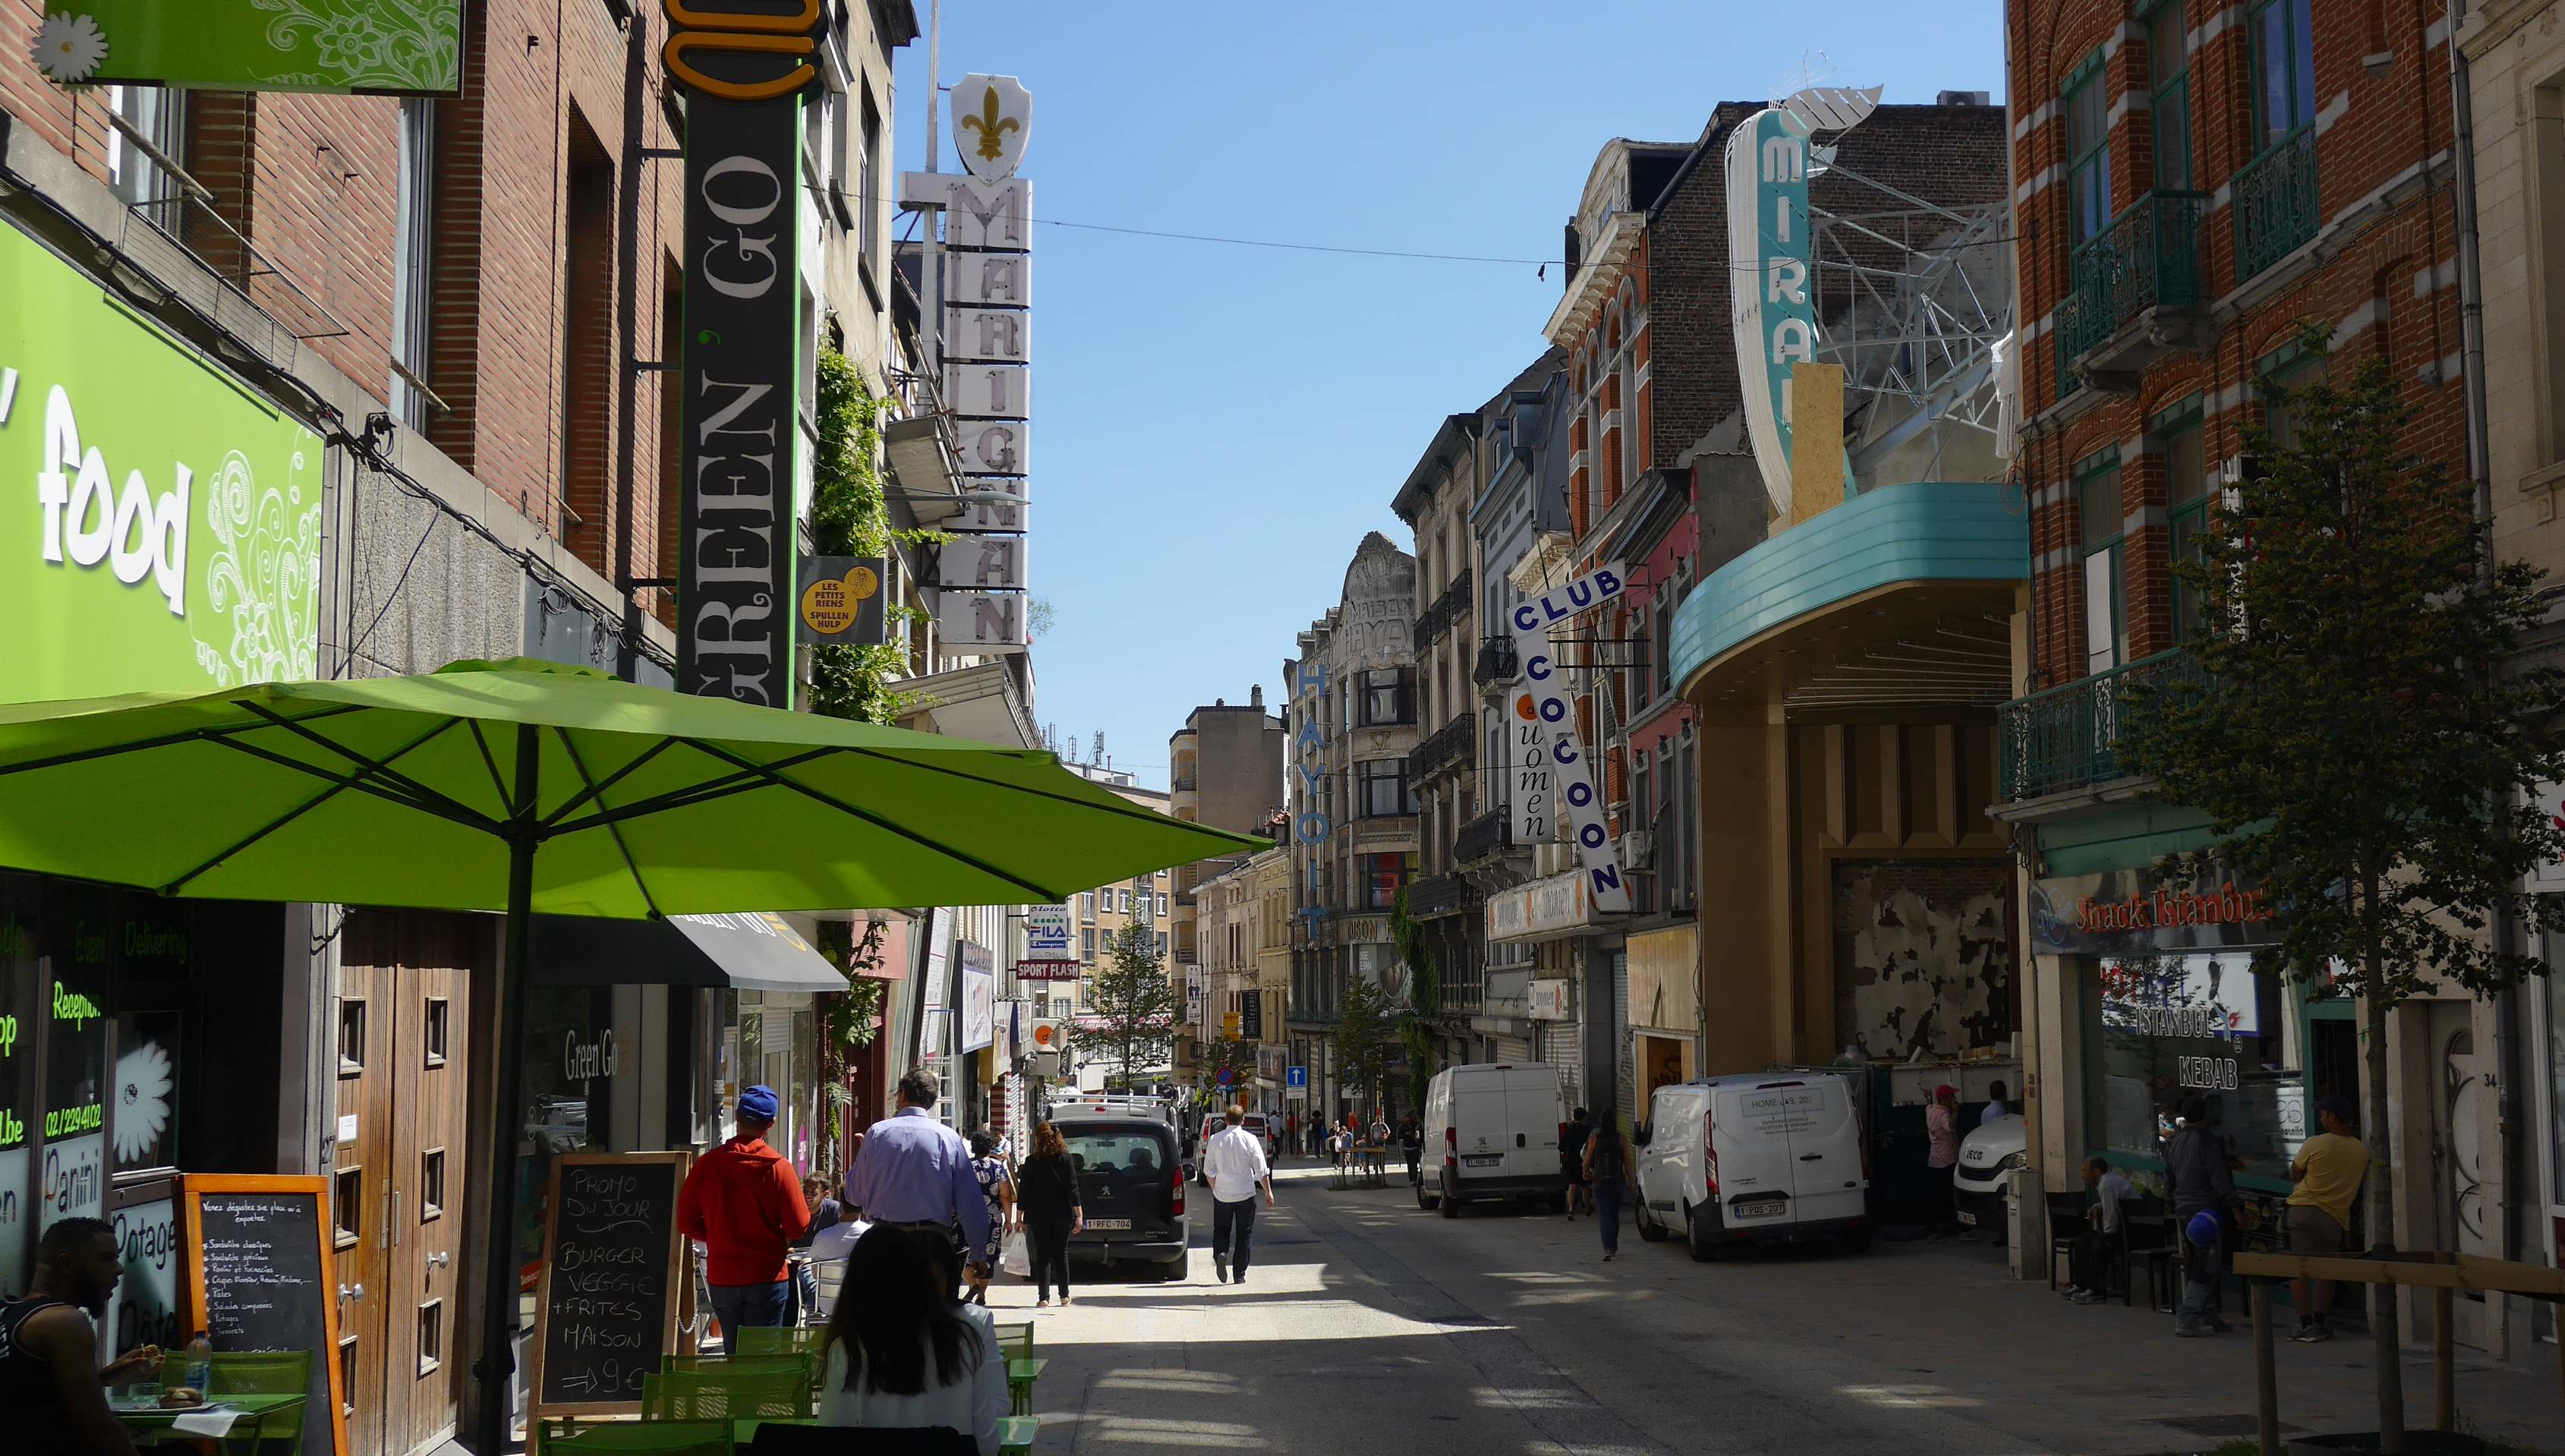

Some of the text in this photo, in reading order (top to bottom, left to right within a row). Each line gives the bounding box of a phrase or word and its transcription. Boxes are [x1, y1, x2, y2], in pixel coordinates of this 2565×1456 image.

[1763, 136, 1810, 424] MIRA
[950, 184, 1019, 643] MARIGNAN
[38, 383, 193, 616] food
[810, 611, 849, 619] SPULLEN
[1353, 598, 1414, 622] MAISON
[1514, 570, 1621, 631] CLUB
[1345, 619, 1409, 655] HAYO
[1527, 654, 1620, 893] COCOON
[1297, 664, 1328, 941] HAYOIT
[2076, 890, 2152, 933] Snack
[124, 920, 187, 965] Delivering
[1030, 926, 1066, 938] FILA
[1018, 963, 1078, 977] SPORT FLASH
[52, 980, 101, 1032] Reception
[2135, 1007, 2214, 1038] ISTANBUL
[2179, 1056, 2239, 1090] KEBAB
[2485, 1073, 2497, 1087] 34
[1752, 1099, 1777, 1108] HOME
[2029, 1087, 2035, 1098] 40
[1964, 1149, 1984, 1161] IVECO
[44, 1148, 99, 1217] Panini
[571, 1169, 636, 1201] PROMO
[603, 1199, 650, 1218] JOUR
[559, 1241, 645, 1271] BURGER
[215, 1313, 238, 1326] Potages
[215, 1325, 244, 1336] Desserts
